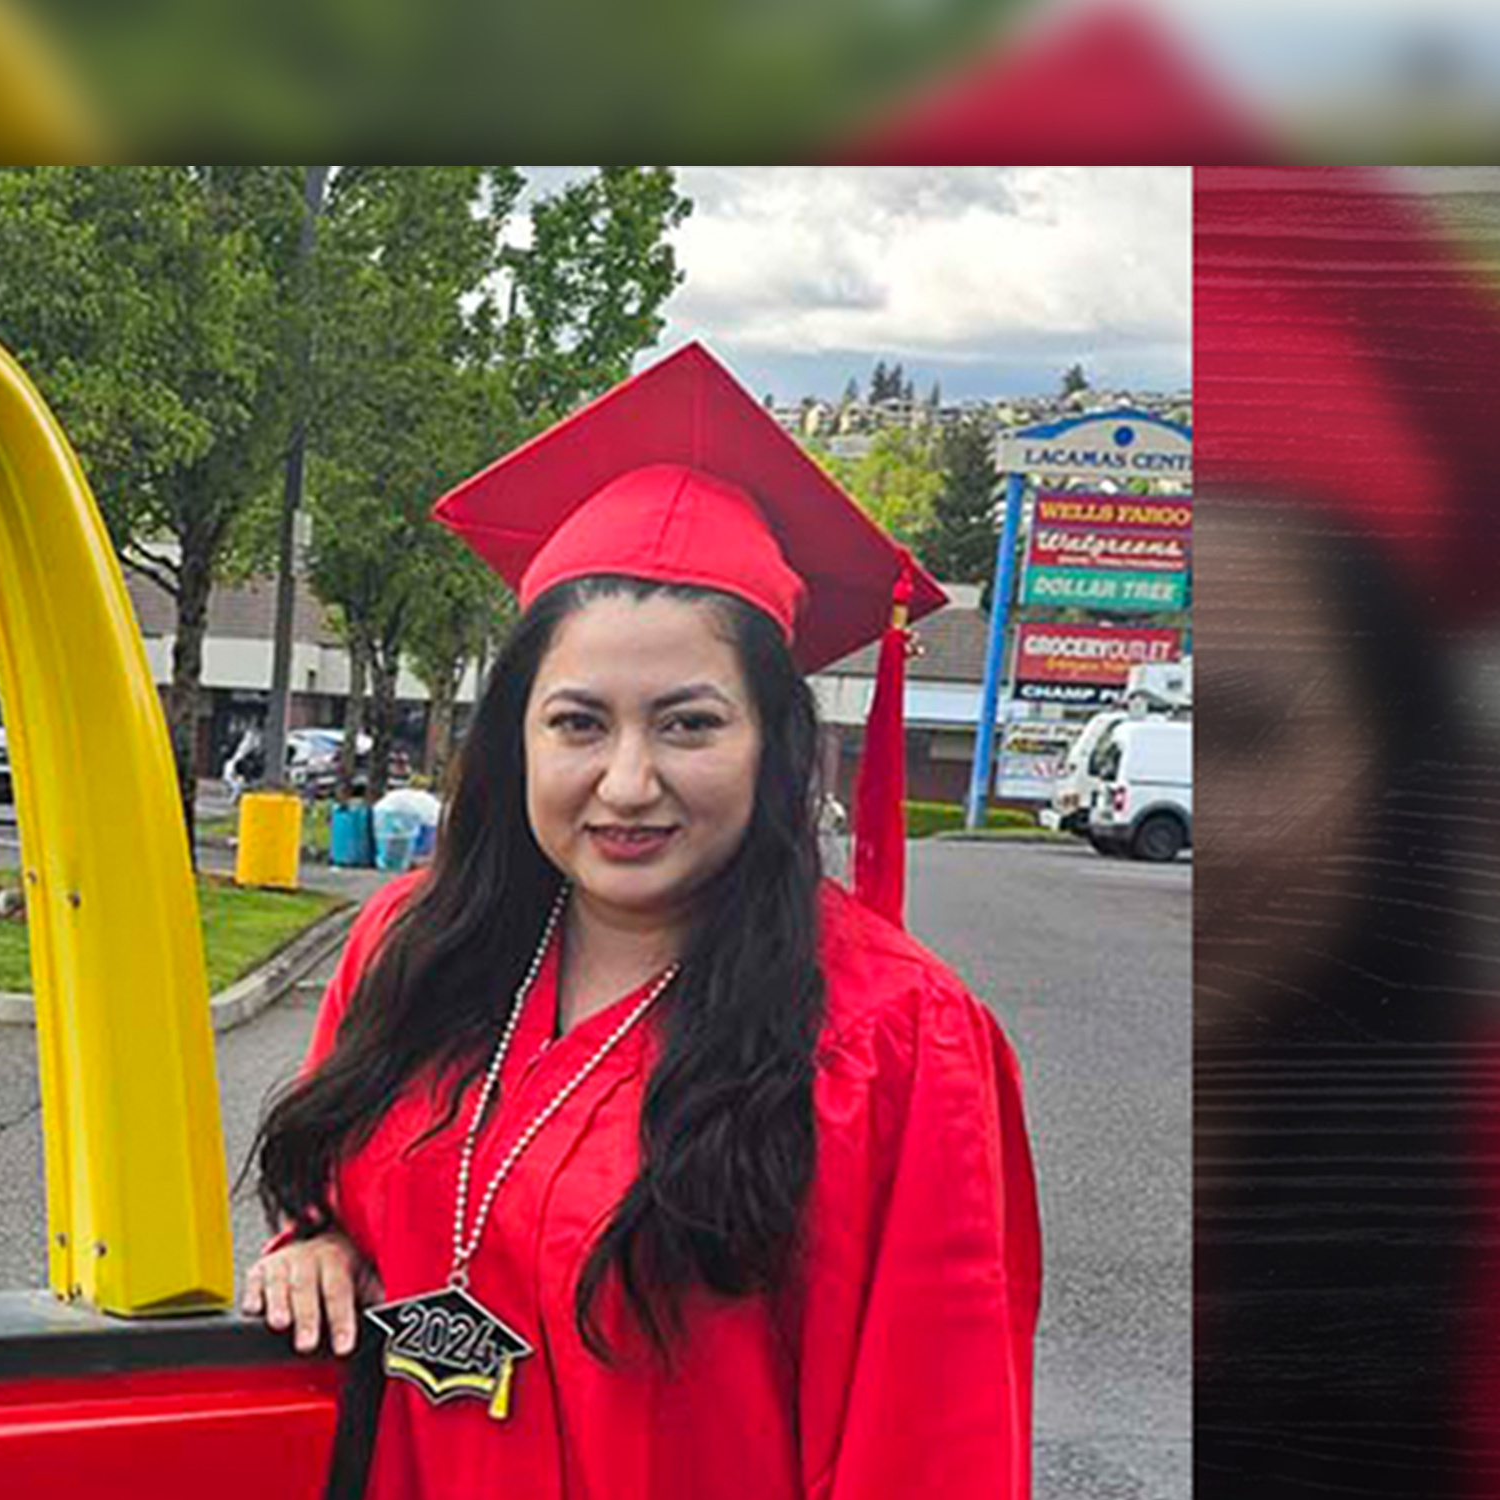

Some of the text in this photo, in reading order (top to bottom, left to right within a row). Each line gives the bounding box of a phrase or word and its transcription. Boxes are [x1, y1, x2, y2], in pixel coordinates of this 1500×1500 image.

[1025, 449, 1192, 470] LACAMAS CENT
[1038, 501, 1192, 526] WELLS FARGO
[1037, 531, 1184, 557] Walgreens
[1033, 576, 1178, 601] DOLLAR TREE
[1020, 684, 1095, 699] CHAMP
[392, 1303, 499, 1375] 2024
